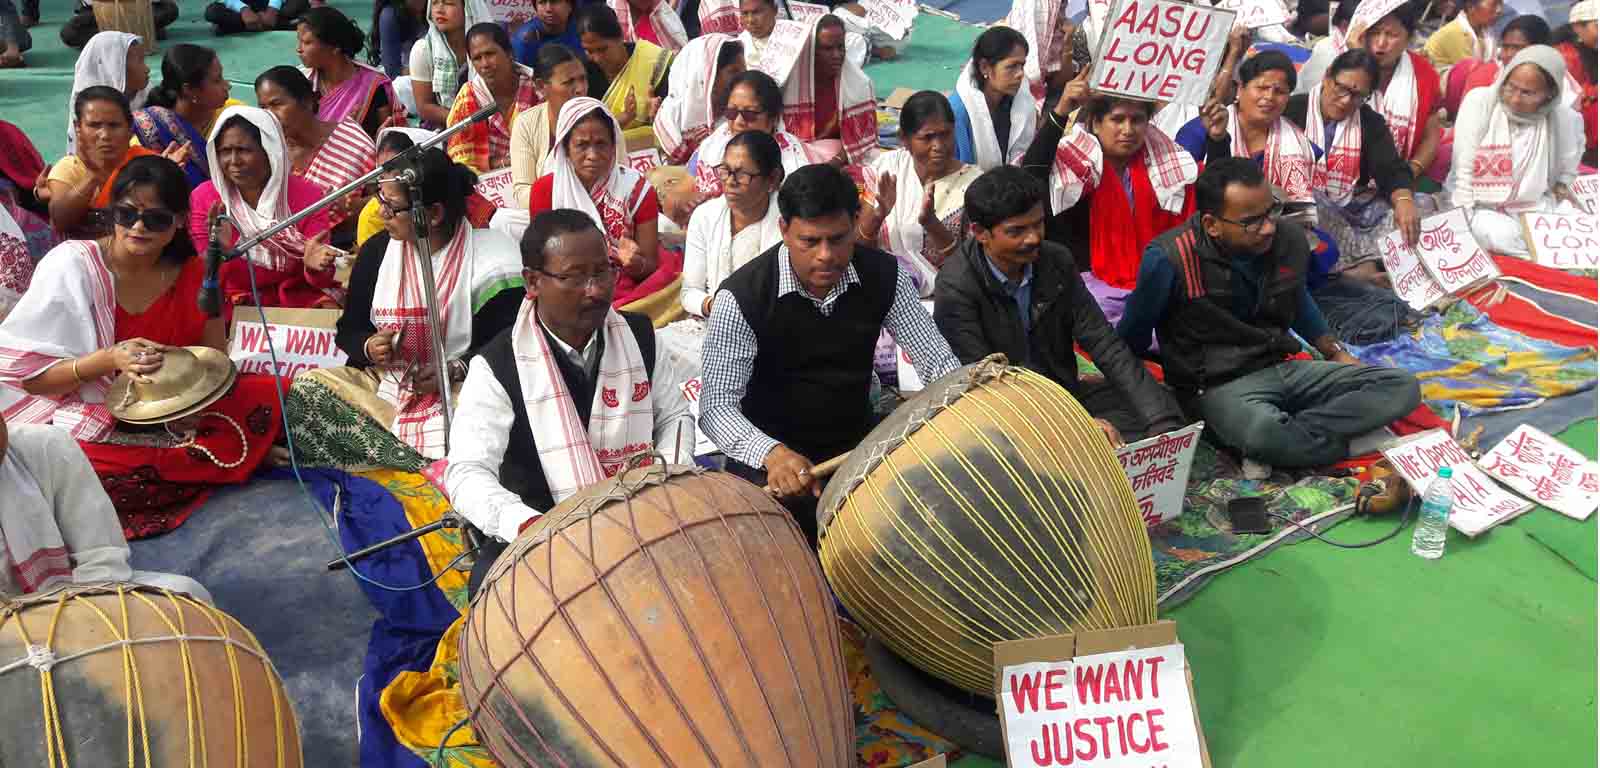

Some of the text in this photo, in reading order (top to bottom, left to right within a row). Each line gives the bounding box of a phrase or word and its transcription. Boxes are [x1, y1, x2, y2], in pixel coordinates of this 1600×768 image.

[1113, 0, 1211, 41] AASU
[1103, 38, 1206, 75] LONG
[1098, 67, 1182, 97] LIVE
[241, 325, 276, 353] WE
[1391, 455, 1429, 481] WE
[1415, 439, 1472, 474] OPPOSE
[1010, 656, 1165, 714] WE WANT
[1030, 709, 1169, 767] JUSTICE
